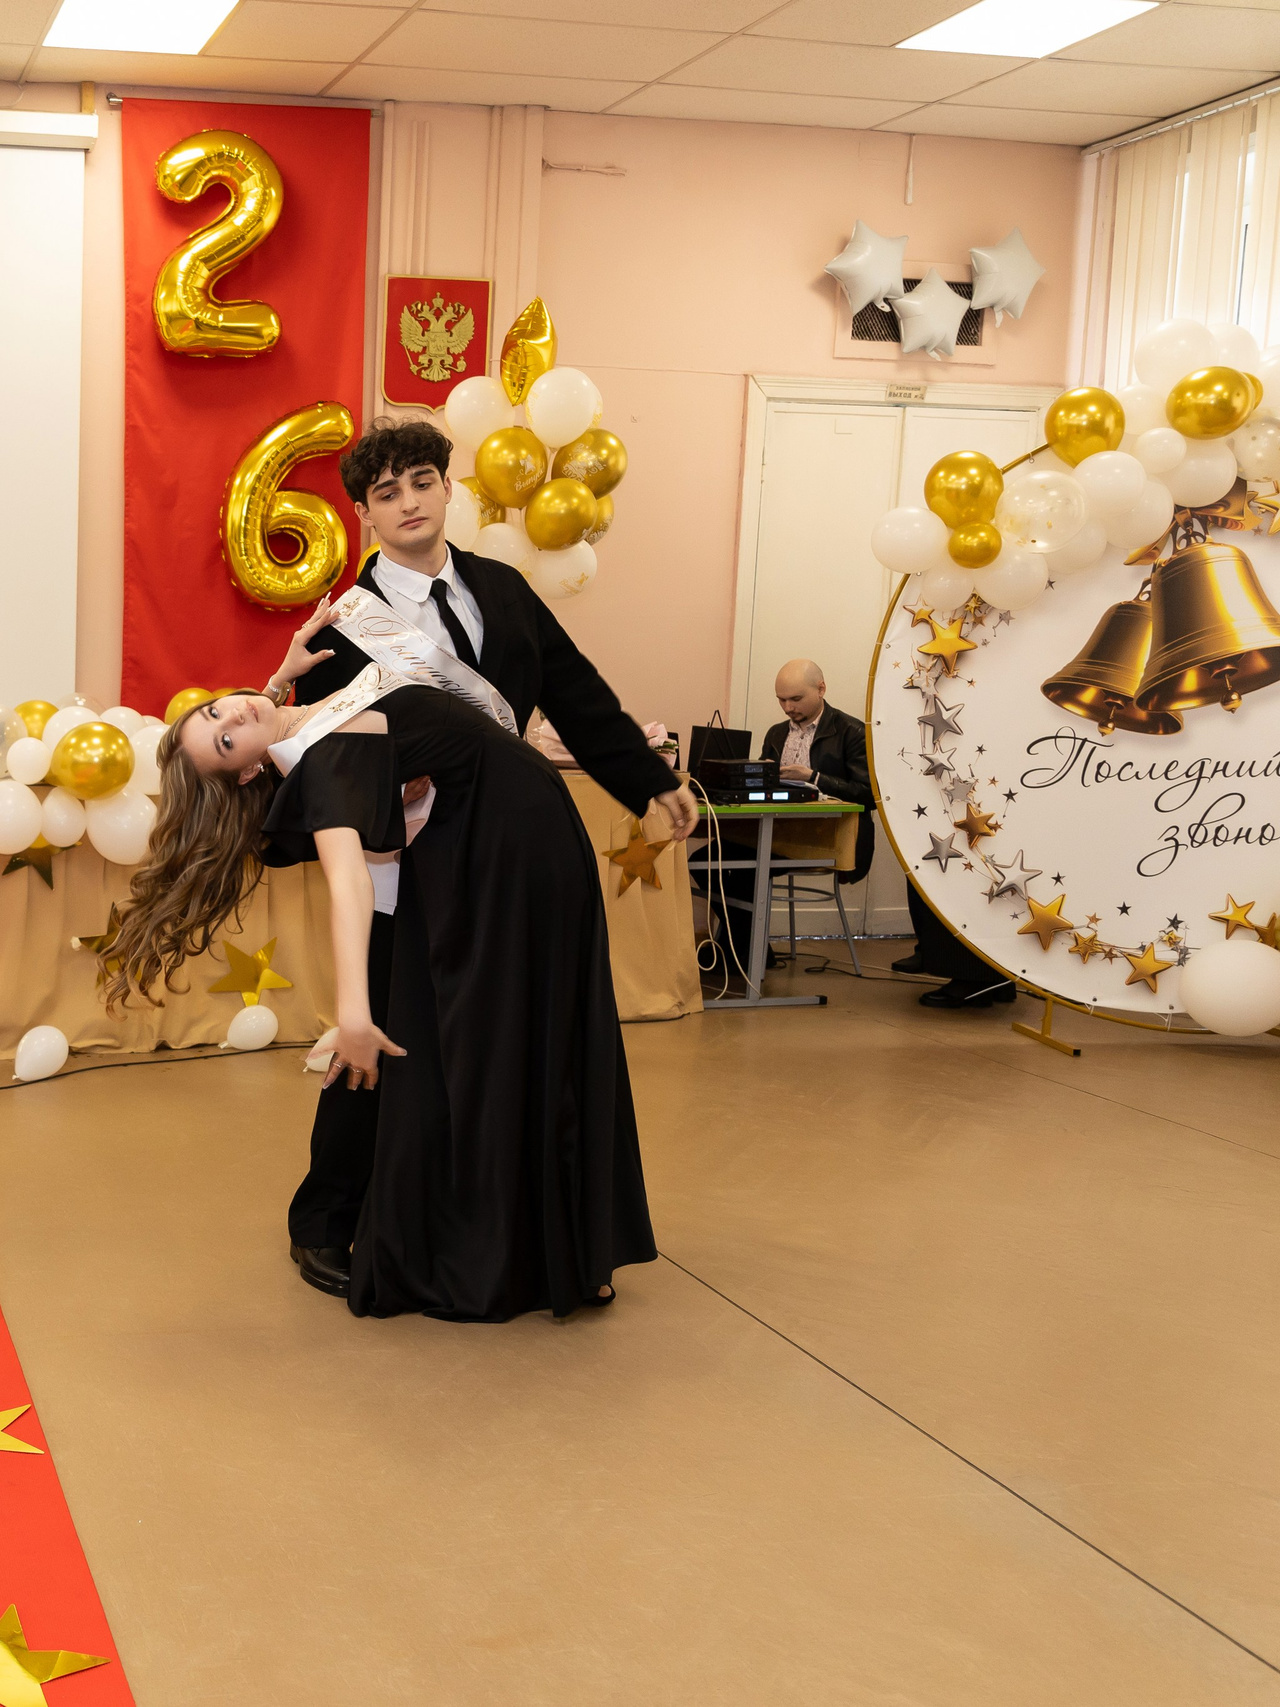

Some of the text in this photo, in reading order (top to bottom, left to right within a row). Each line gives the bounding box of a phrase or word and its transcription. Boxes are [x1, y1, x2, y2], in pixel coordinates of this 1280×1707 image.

[152, 129, 284, 358] 2
[888, 391, 912, 399] ВЫХОД
[220, 400, 354, 611] 6
